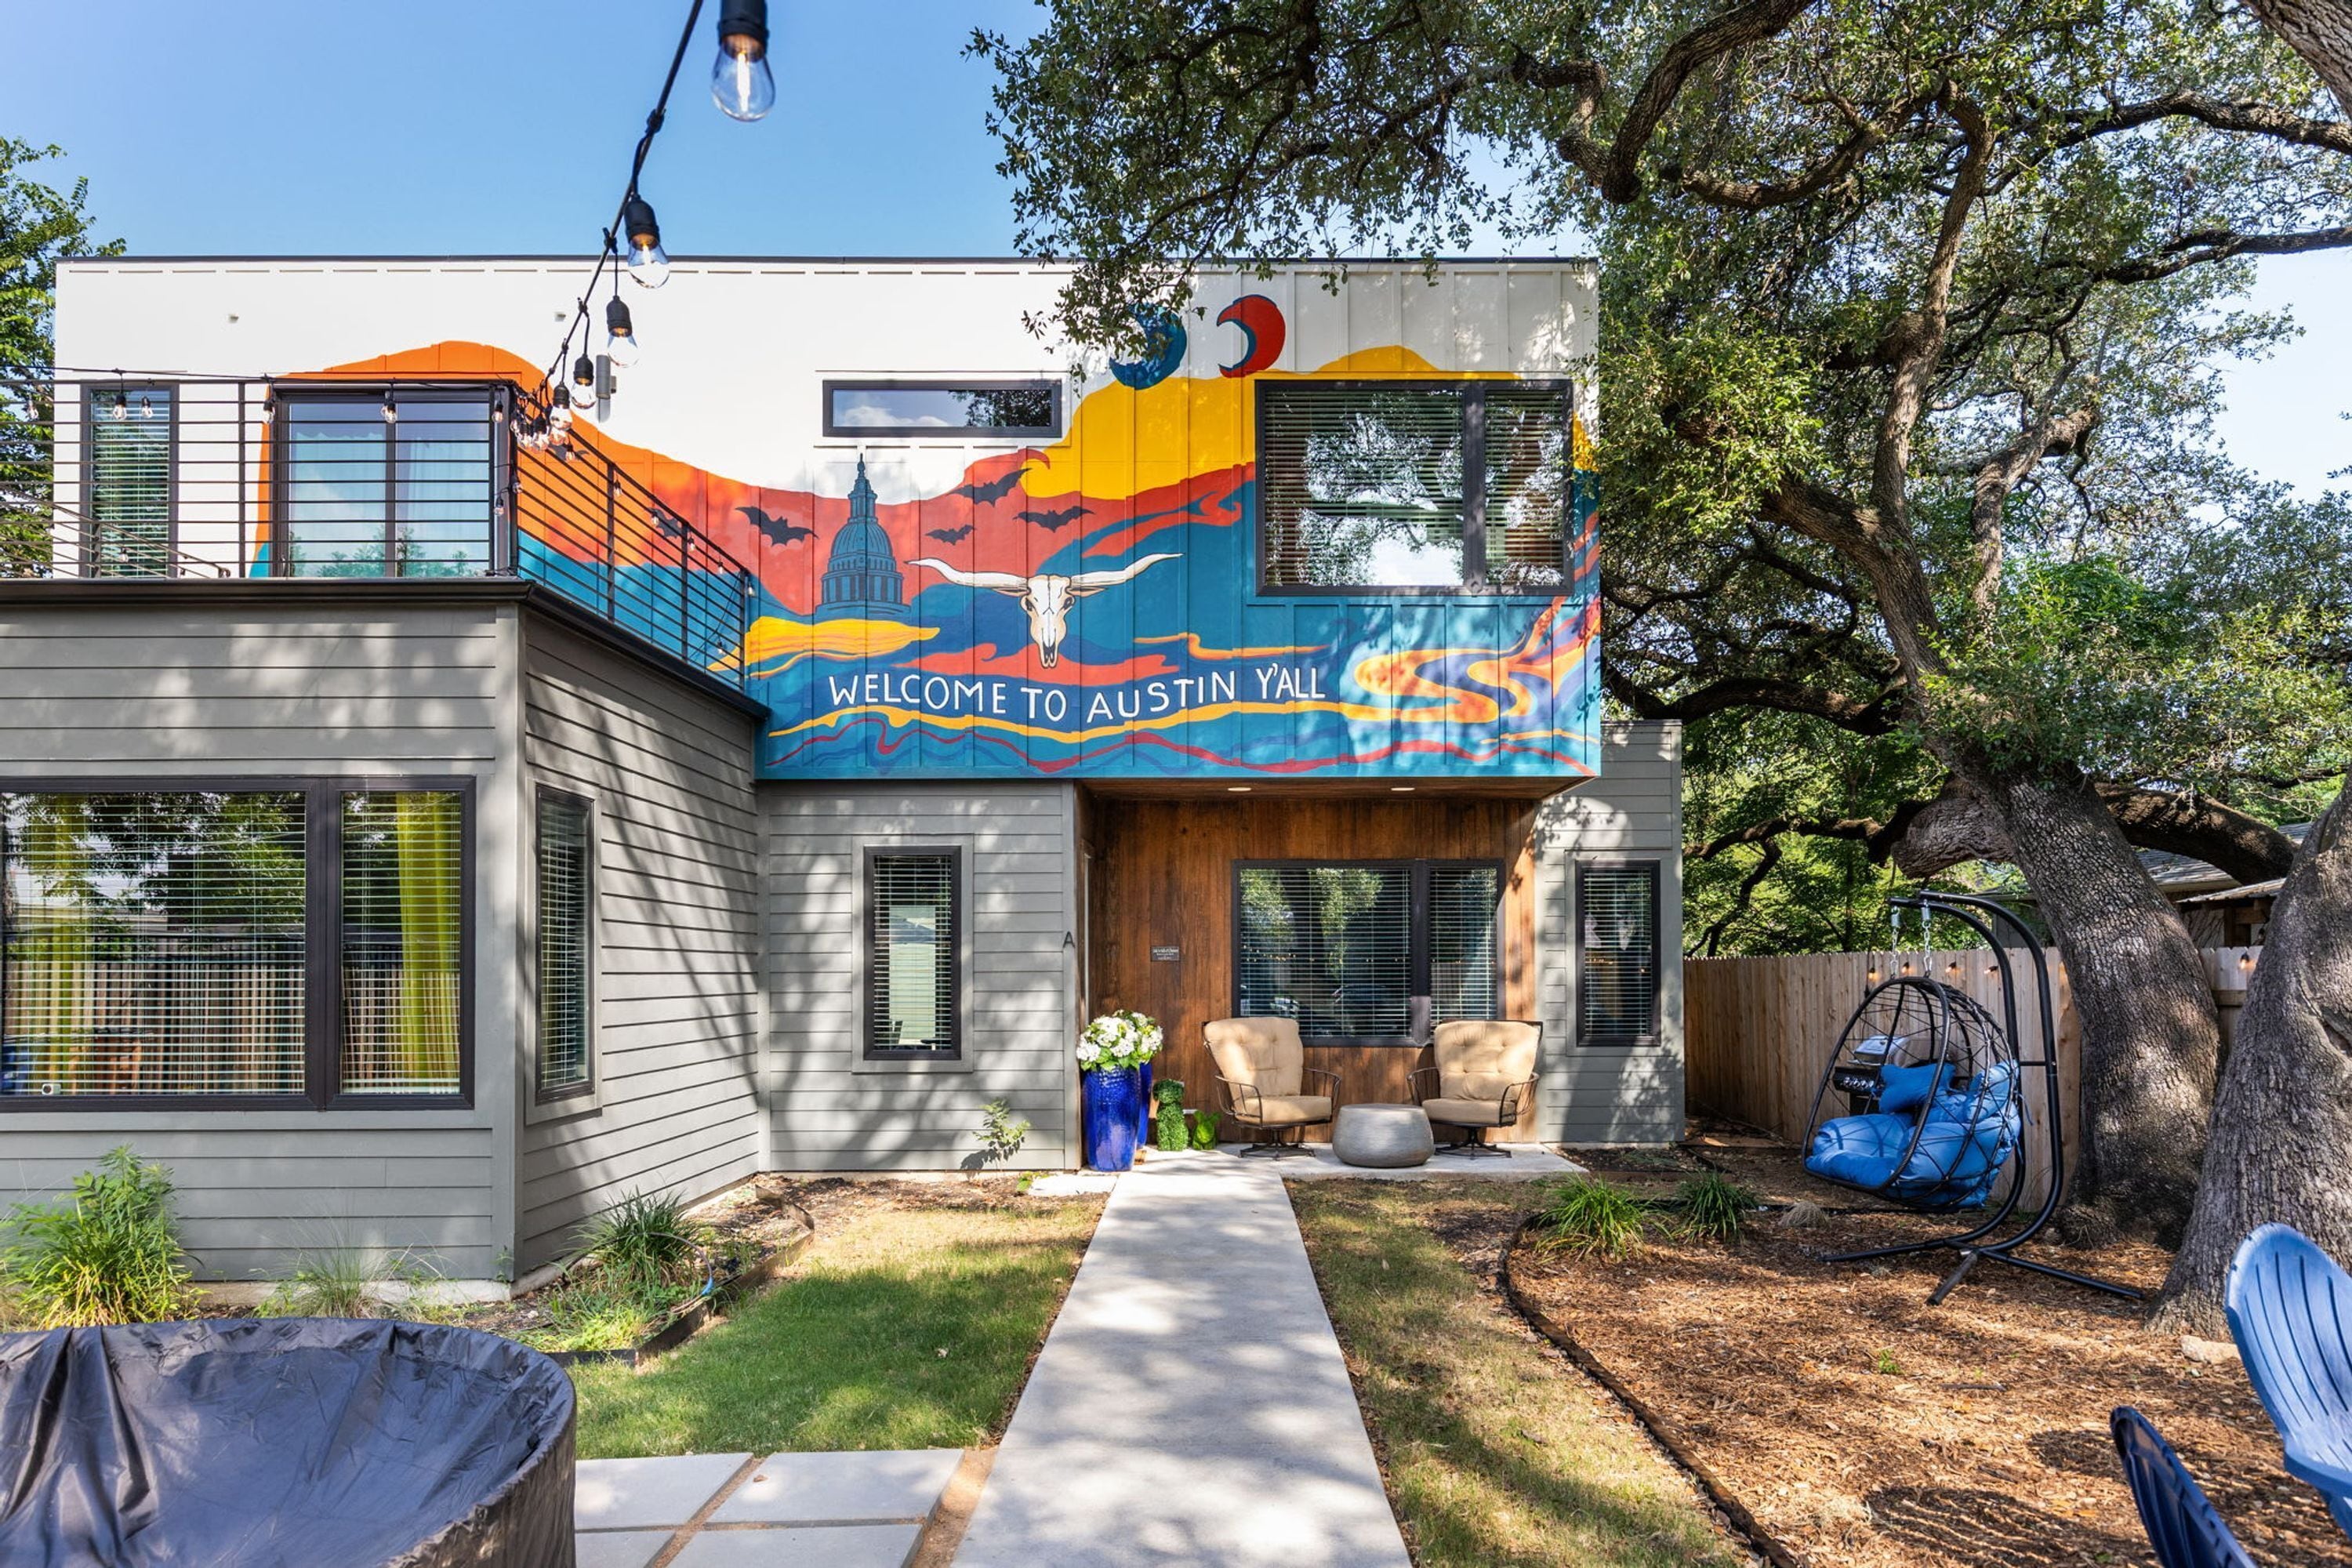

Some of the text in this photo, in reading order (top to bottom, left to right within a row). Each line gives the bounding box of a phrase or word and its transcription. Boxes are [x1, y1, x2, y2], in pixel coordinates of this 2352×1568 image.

[829, 663, 1325, 722] WELCOME TO AUSTIN Y'ALL
[1062, 931, 1076, 949] A
